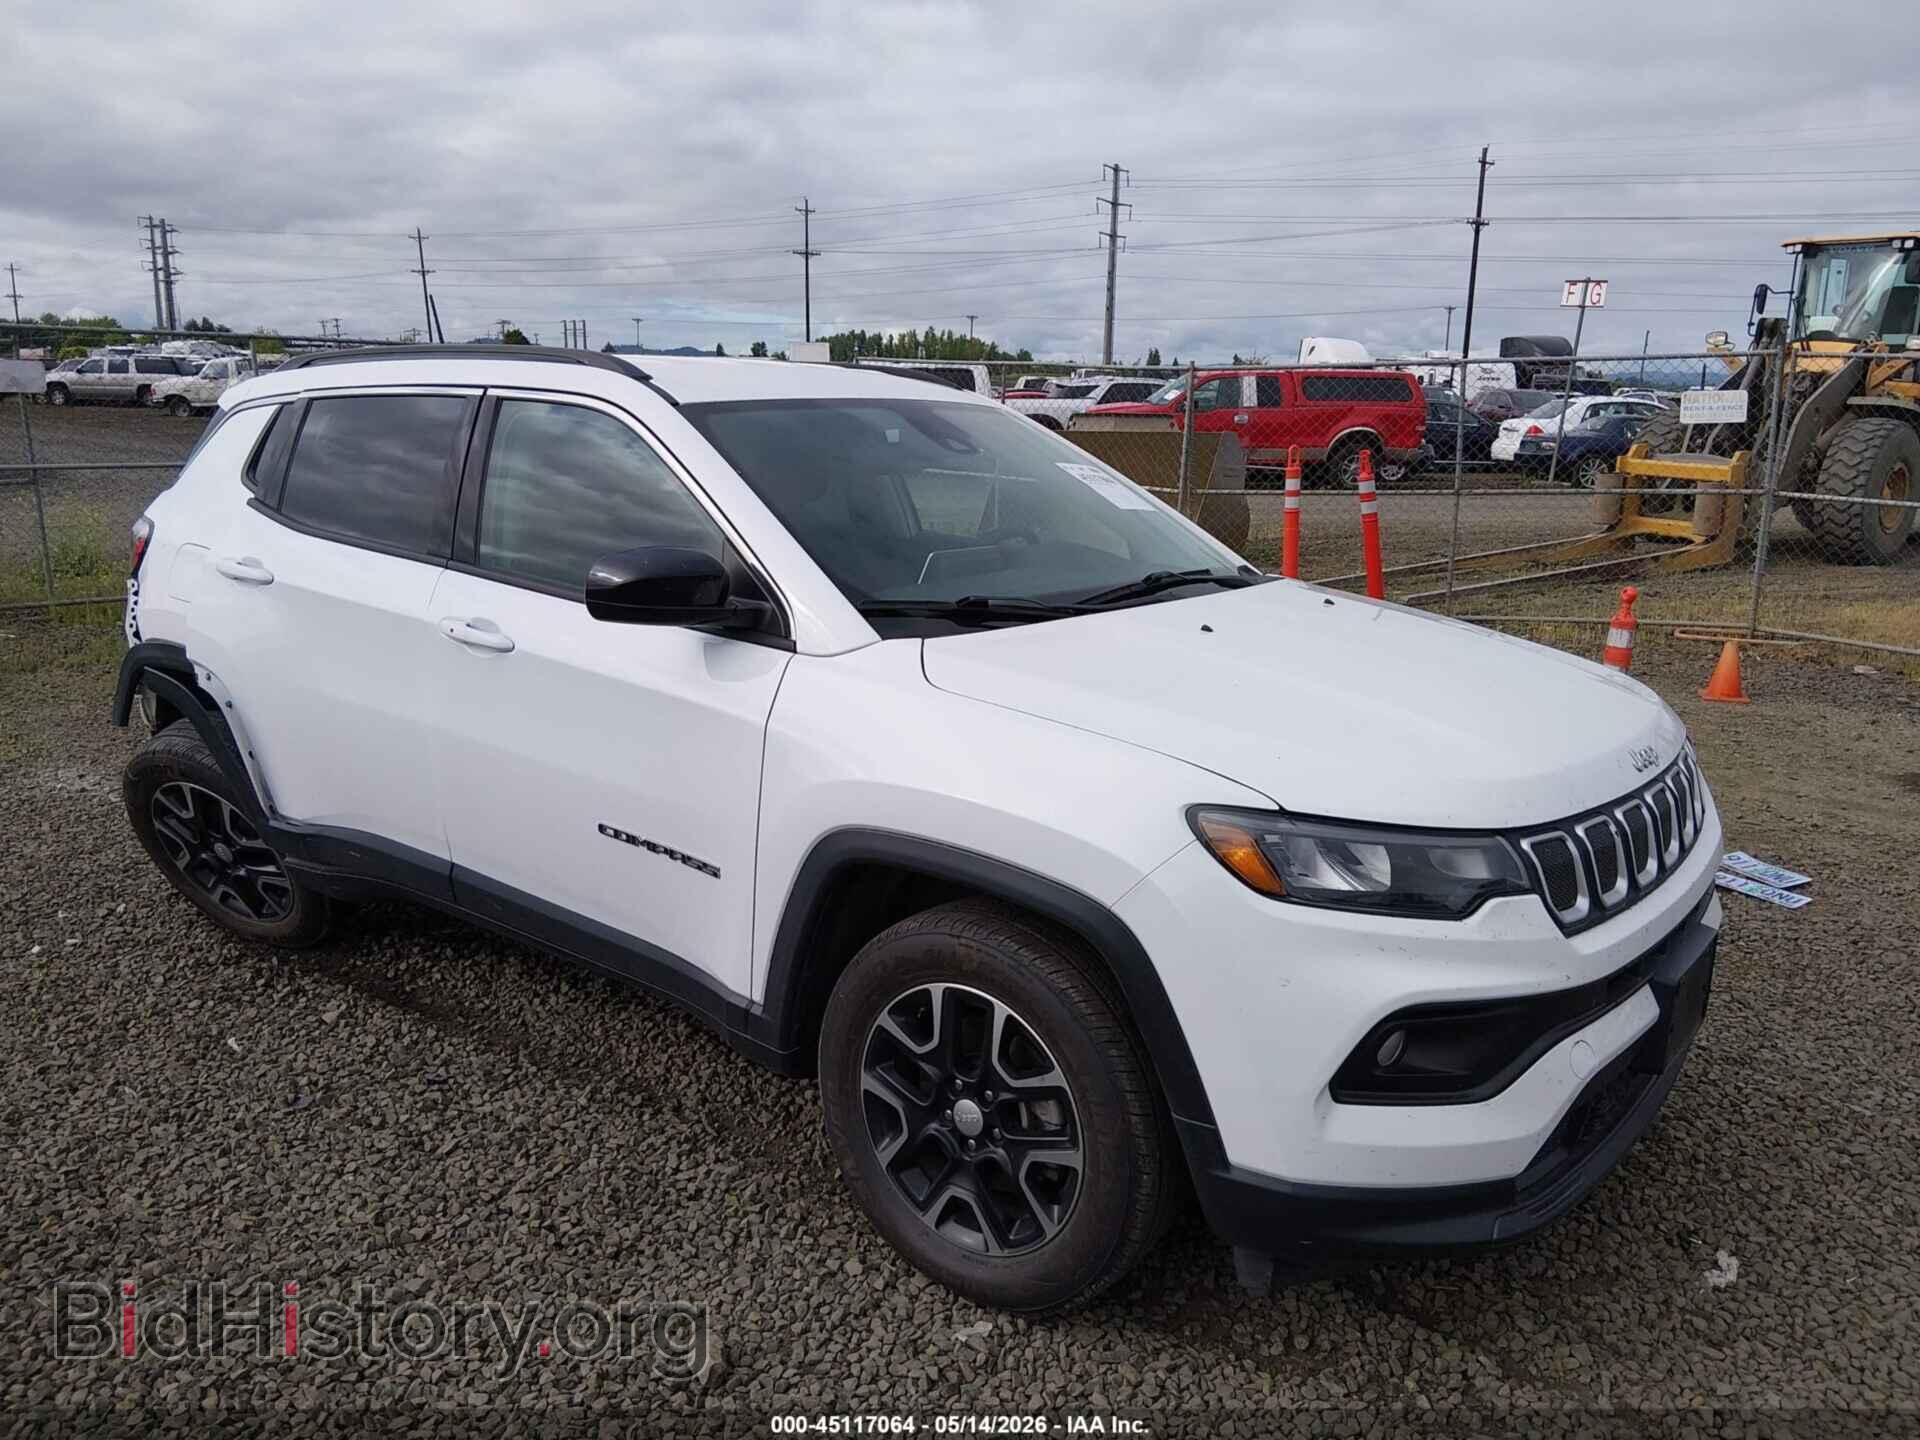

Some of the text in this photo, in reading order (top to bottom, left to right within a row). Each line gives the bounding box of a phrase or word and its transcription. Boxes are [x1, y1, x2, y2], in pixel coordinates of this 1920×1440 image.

[1566, 281, 1602, 305] F G
[1630, 746, 1659, 772] Jeep
[598, 823, 721, 879] COMPASS
